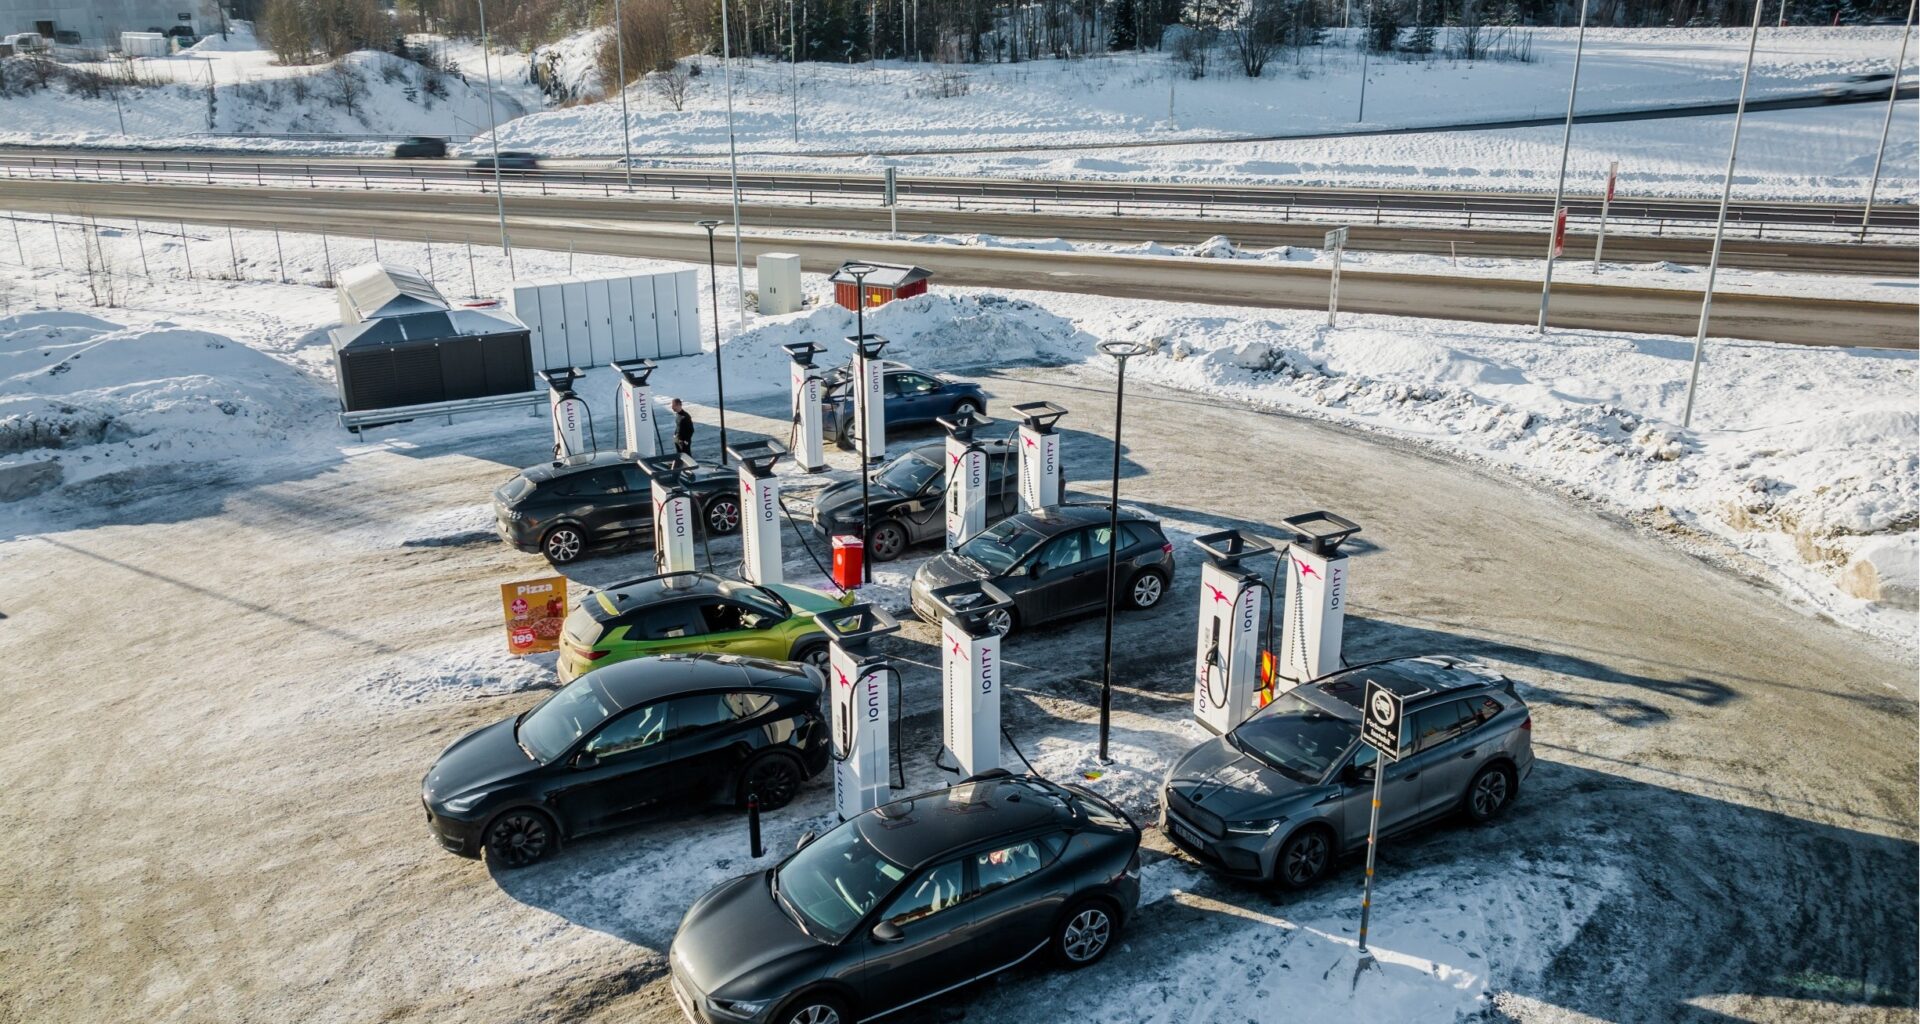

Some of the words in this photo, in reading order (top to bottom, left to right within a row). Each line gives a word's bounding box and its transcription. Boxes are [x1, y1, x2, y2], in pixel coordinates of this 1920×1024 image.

[566, 402, 575, 432] IONITY
[675, 500, 684, 536] IONITY
[764, 486, 772, 521] IONITY
[517, 584, 552, 595] Pizza
[1331, 568, 1341, 610] IONITY
[1244, 590, 1254, 632] IONITY
[512, 633, 534, 644] 199
[982, 648, 991, 694] IONITY
[1199, 666, 1208, 713] IONITY
[868, 674, 879, 722] IONITY
